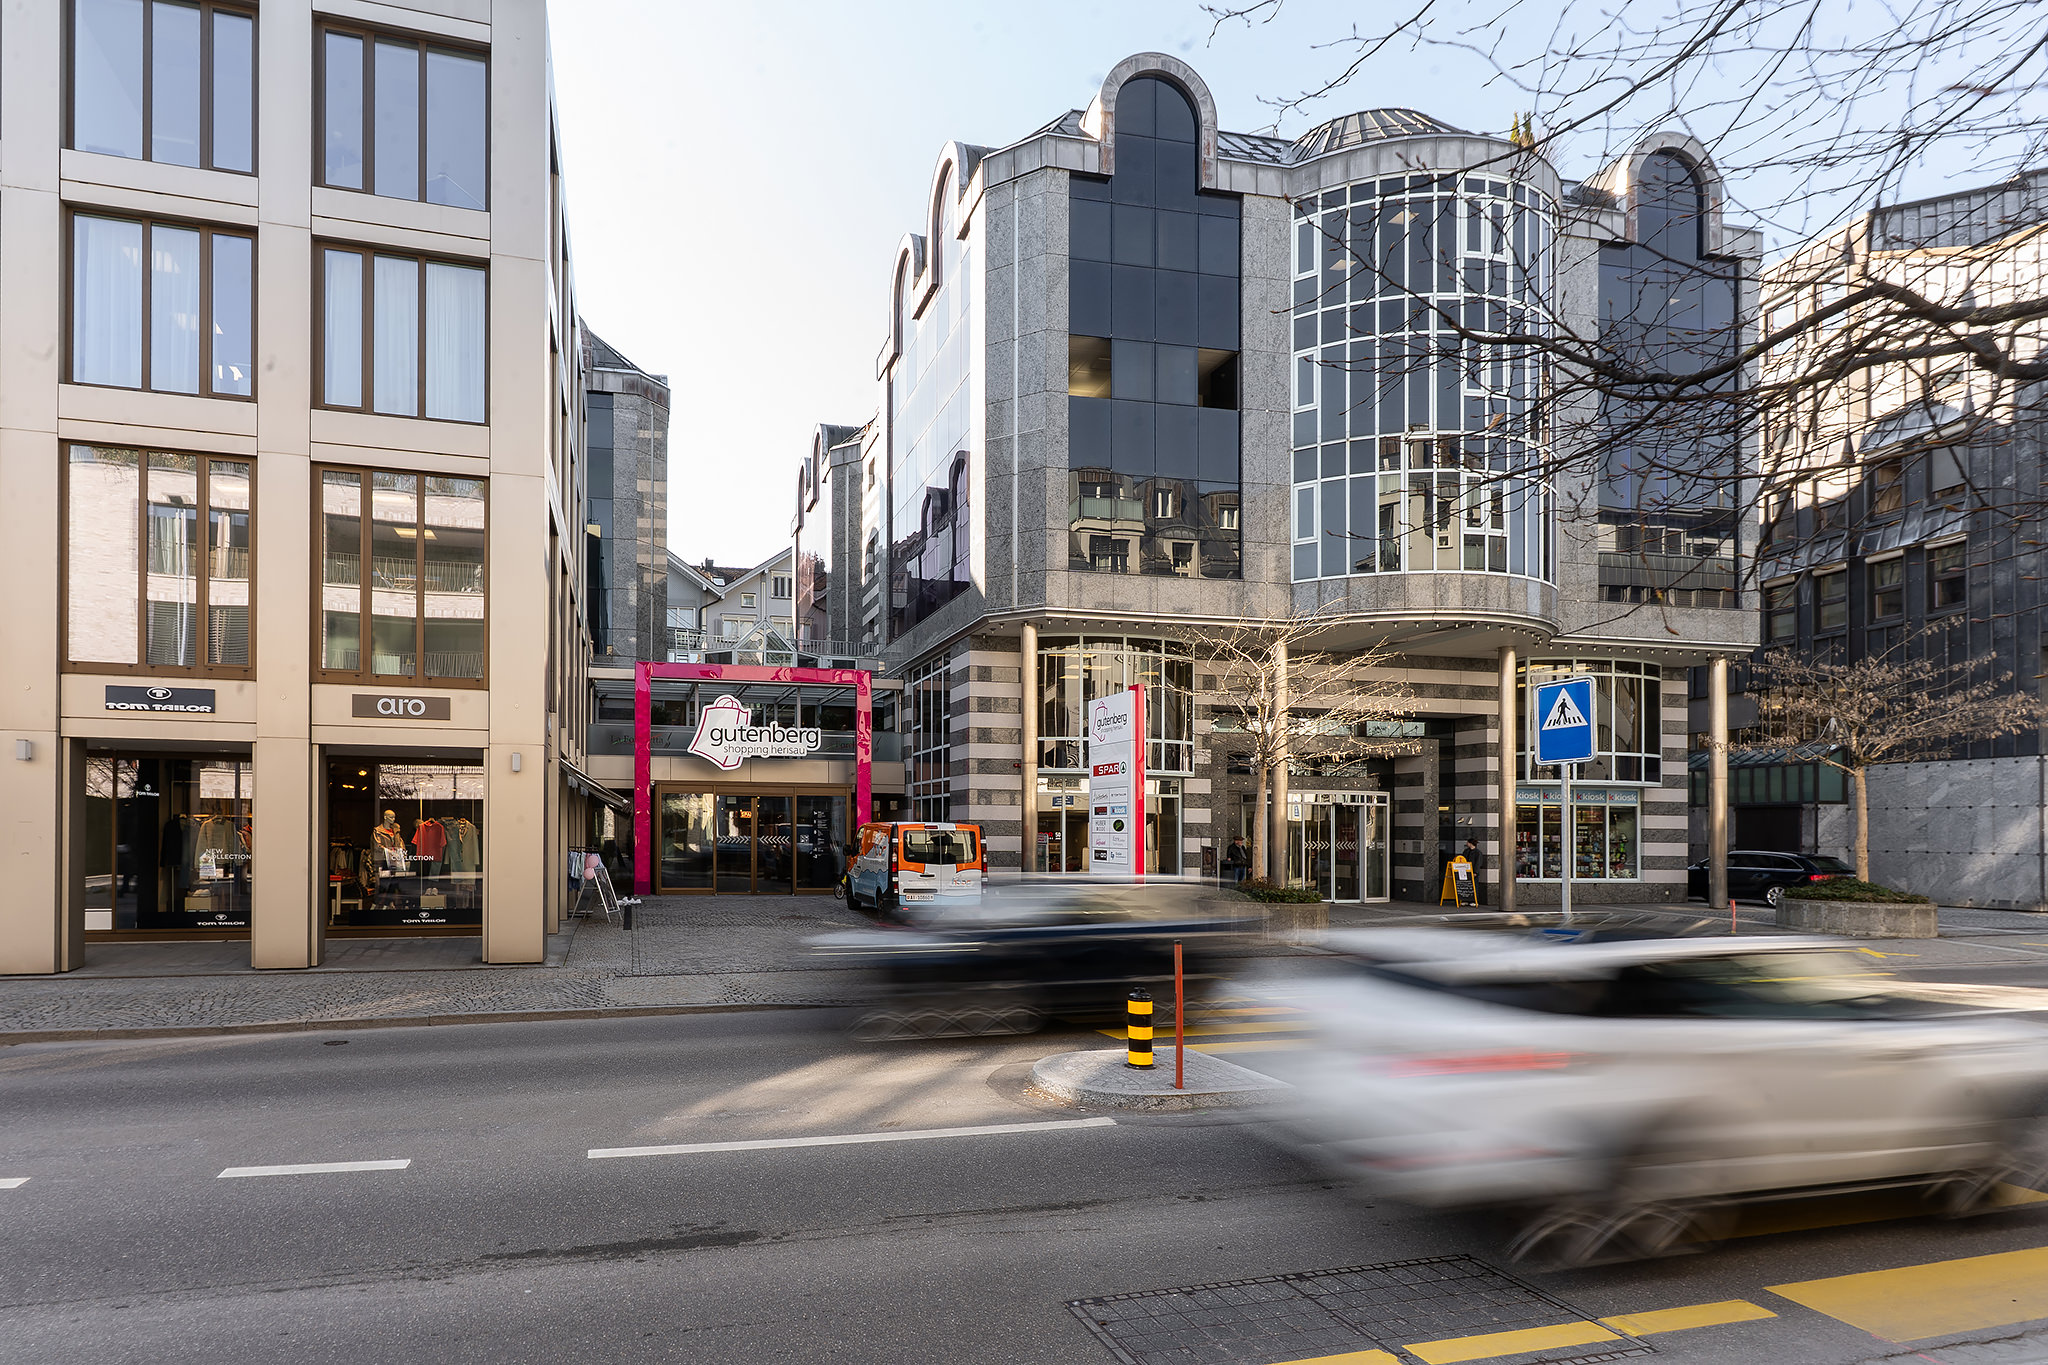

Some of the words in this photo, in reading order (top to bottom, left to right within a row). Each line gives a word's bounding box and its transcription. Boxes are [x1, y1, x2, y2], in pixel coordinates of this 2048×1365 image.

[105, 702, 150, 710] TOM
[152, 703, 212, 713] TAILOR
[376, 697, 426, 716] aro
[1096, 713, 1128, 731] gutenberg
[710, 723, 819, 748] gutenberg
[723, 744, 769, 756] shopping
[771, 745, 805, 755] herisau
[1098, 763, 1120, 775] SPAR
[1516, 791, 1539, 800] kiosk
[1582, 791, 1605, 801] kiosk
[1614, 792, 1637, 801] kiosk
